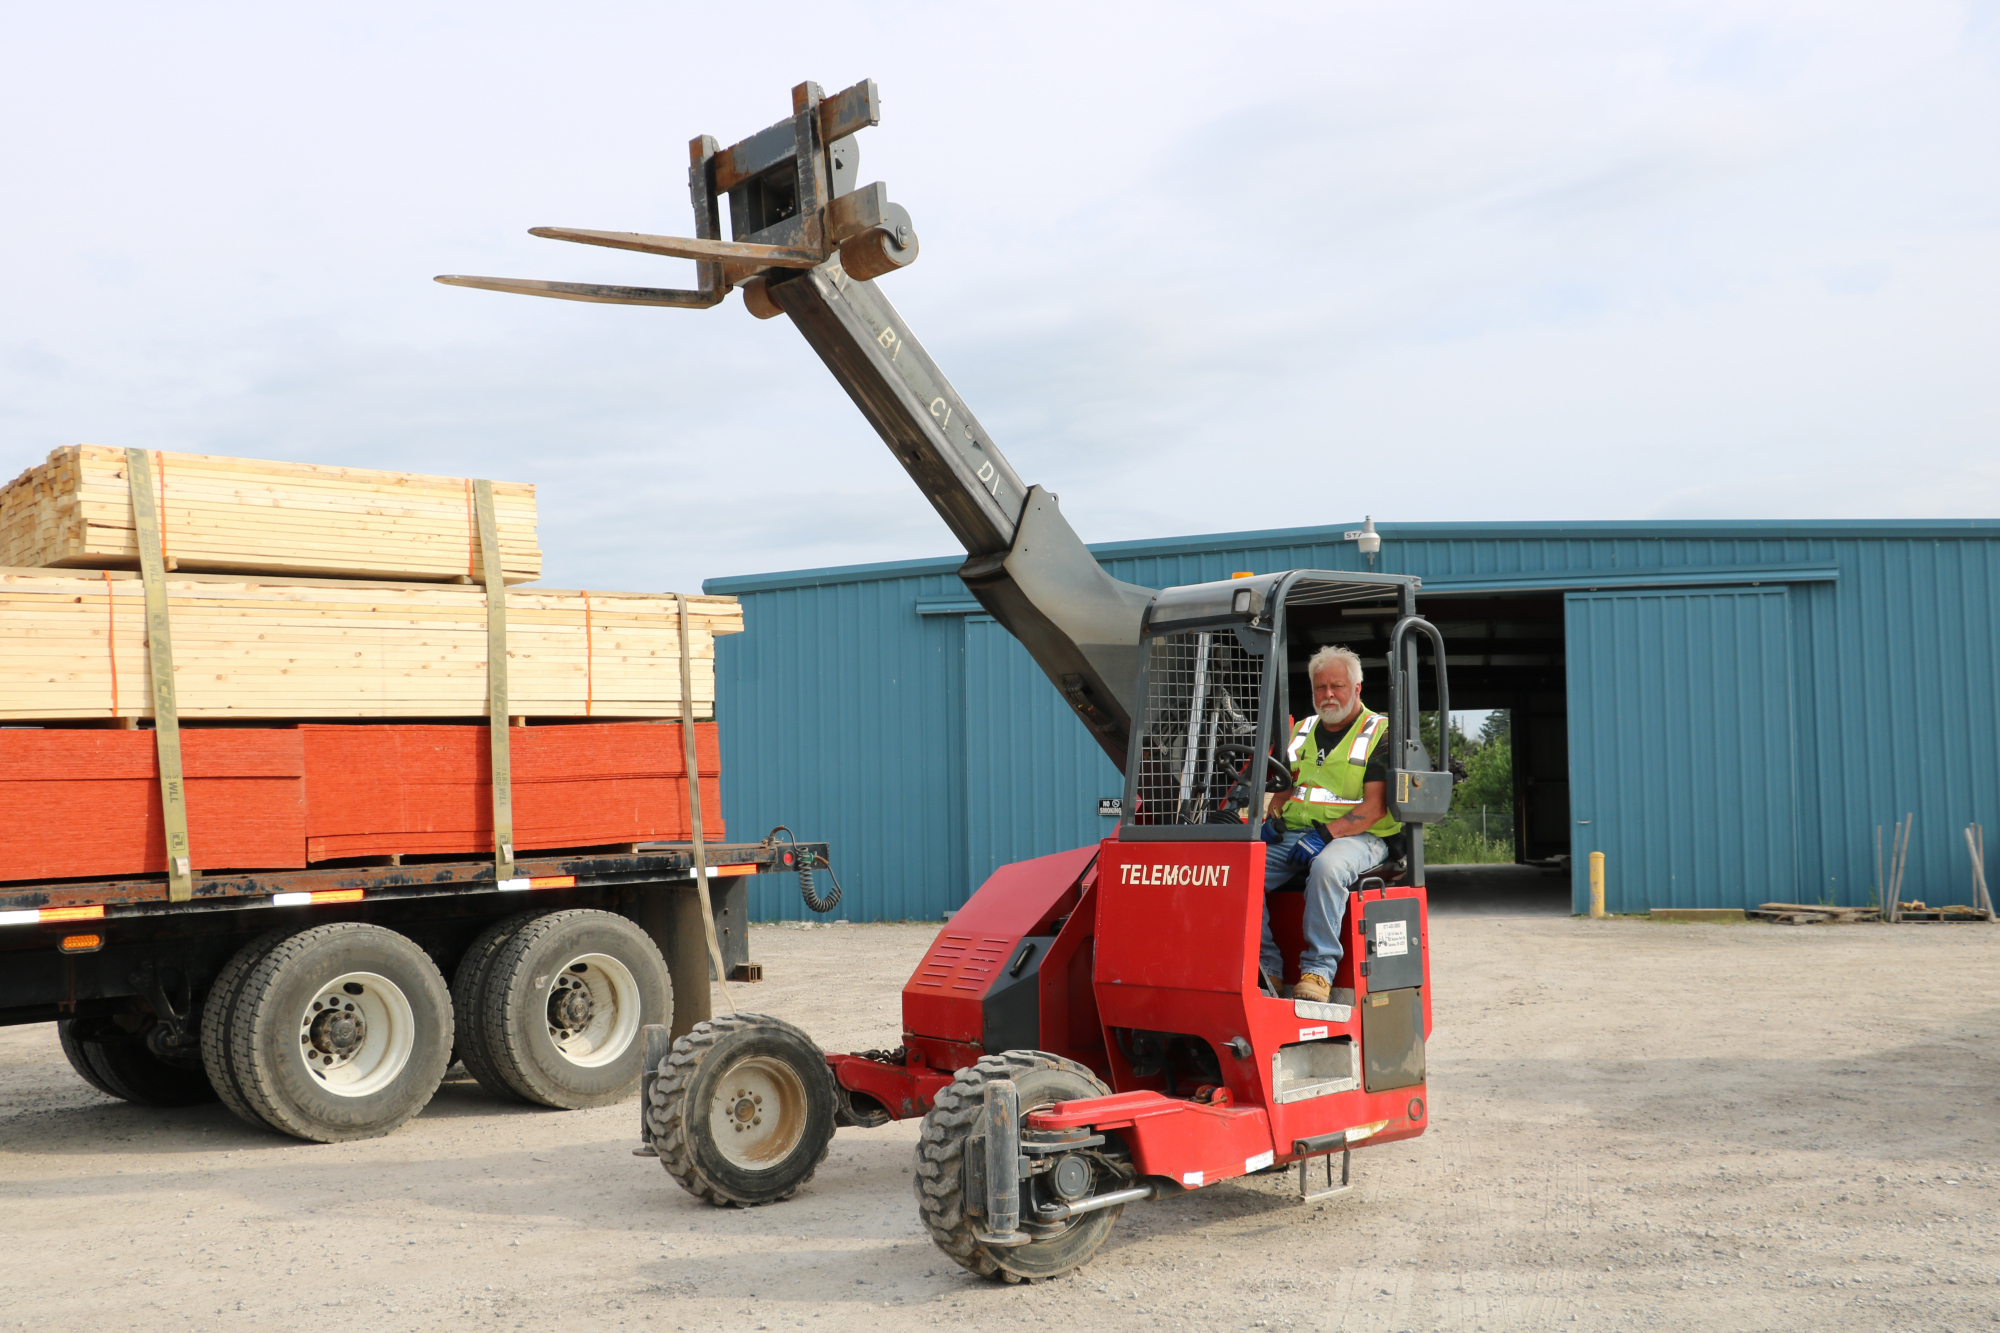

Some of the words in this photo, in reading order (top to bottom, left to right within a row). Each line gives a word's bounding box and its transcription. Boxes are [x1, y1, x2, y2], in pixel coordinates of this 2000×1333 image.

[148, 562, 160, 584] WLL
[152, 634, 175, 732] ANCRA
[168, 781, 178, 803] WLL
[498, 787, 506, 806] WLL
[1120, 864, 1230, 887] TELEMOUNT
